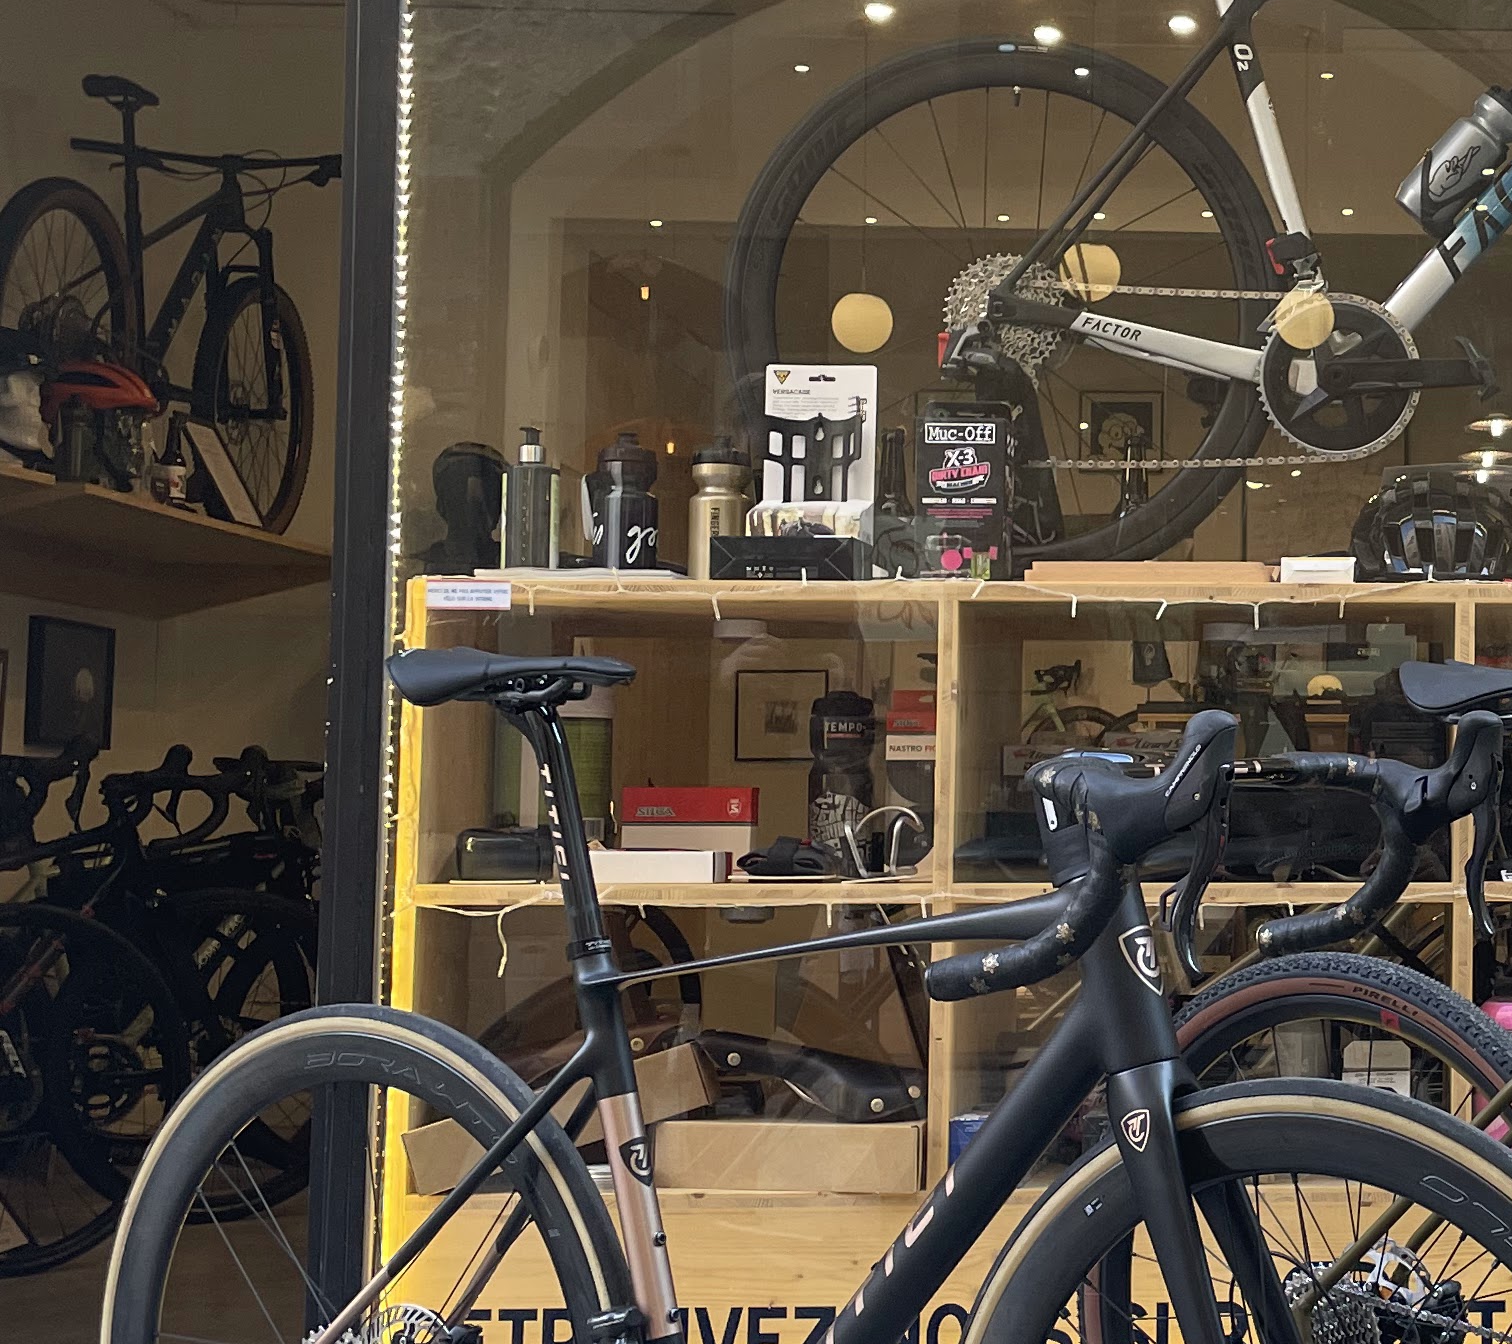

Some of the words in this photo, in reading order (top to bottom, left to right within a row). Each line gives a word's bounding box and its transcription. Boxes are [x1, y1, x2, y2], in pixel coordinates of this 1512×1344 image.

[1081, 317, 1142, 342] FACTOR
[928, 426, 993, 442] Muc-Off
[825, 720, 865, 733] TEMPO
[889, 745, 924, 754] NASTRO
[1352, 986, 1419, 1017] PIRELLI
